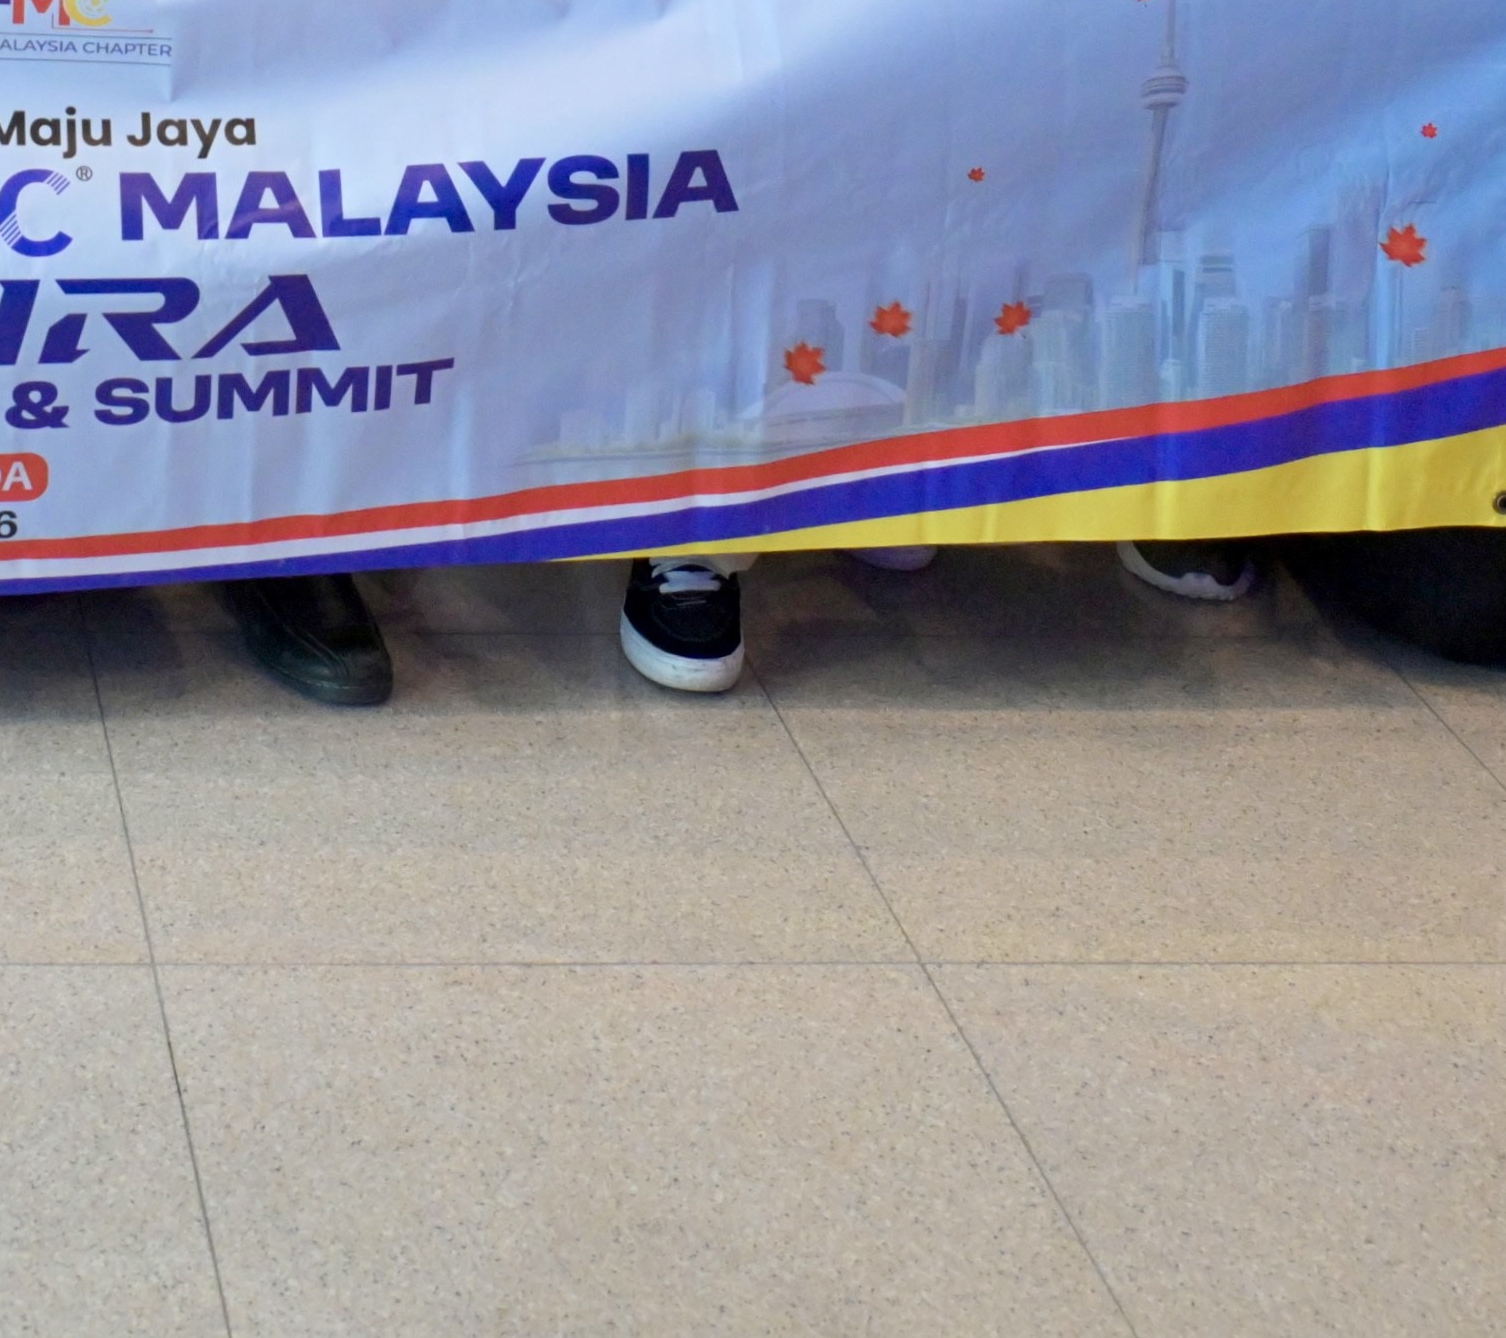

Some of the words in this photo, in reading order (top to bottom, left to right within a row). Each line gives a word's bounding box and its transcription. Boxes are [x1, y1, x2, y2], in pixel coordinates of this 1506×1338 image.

[82, 40, 172, 58] CHAPTER
[125, 112, 259, 160] Jaya
[120, 149, 740, 242] MALAYSIA
[4, 382, 70, 430] &
[94, 357, 456, 426] SUMMIT
